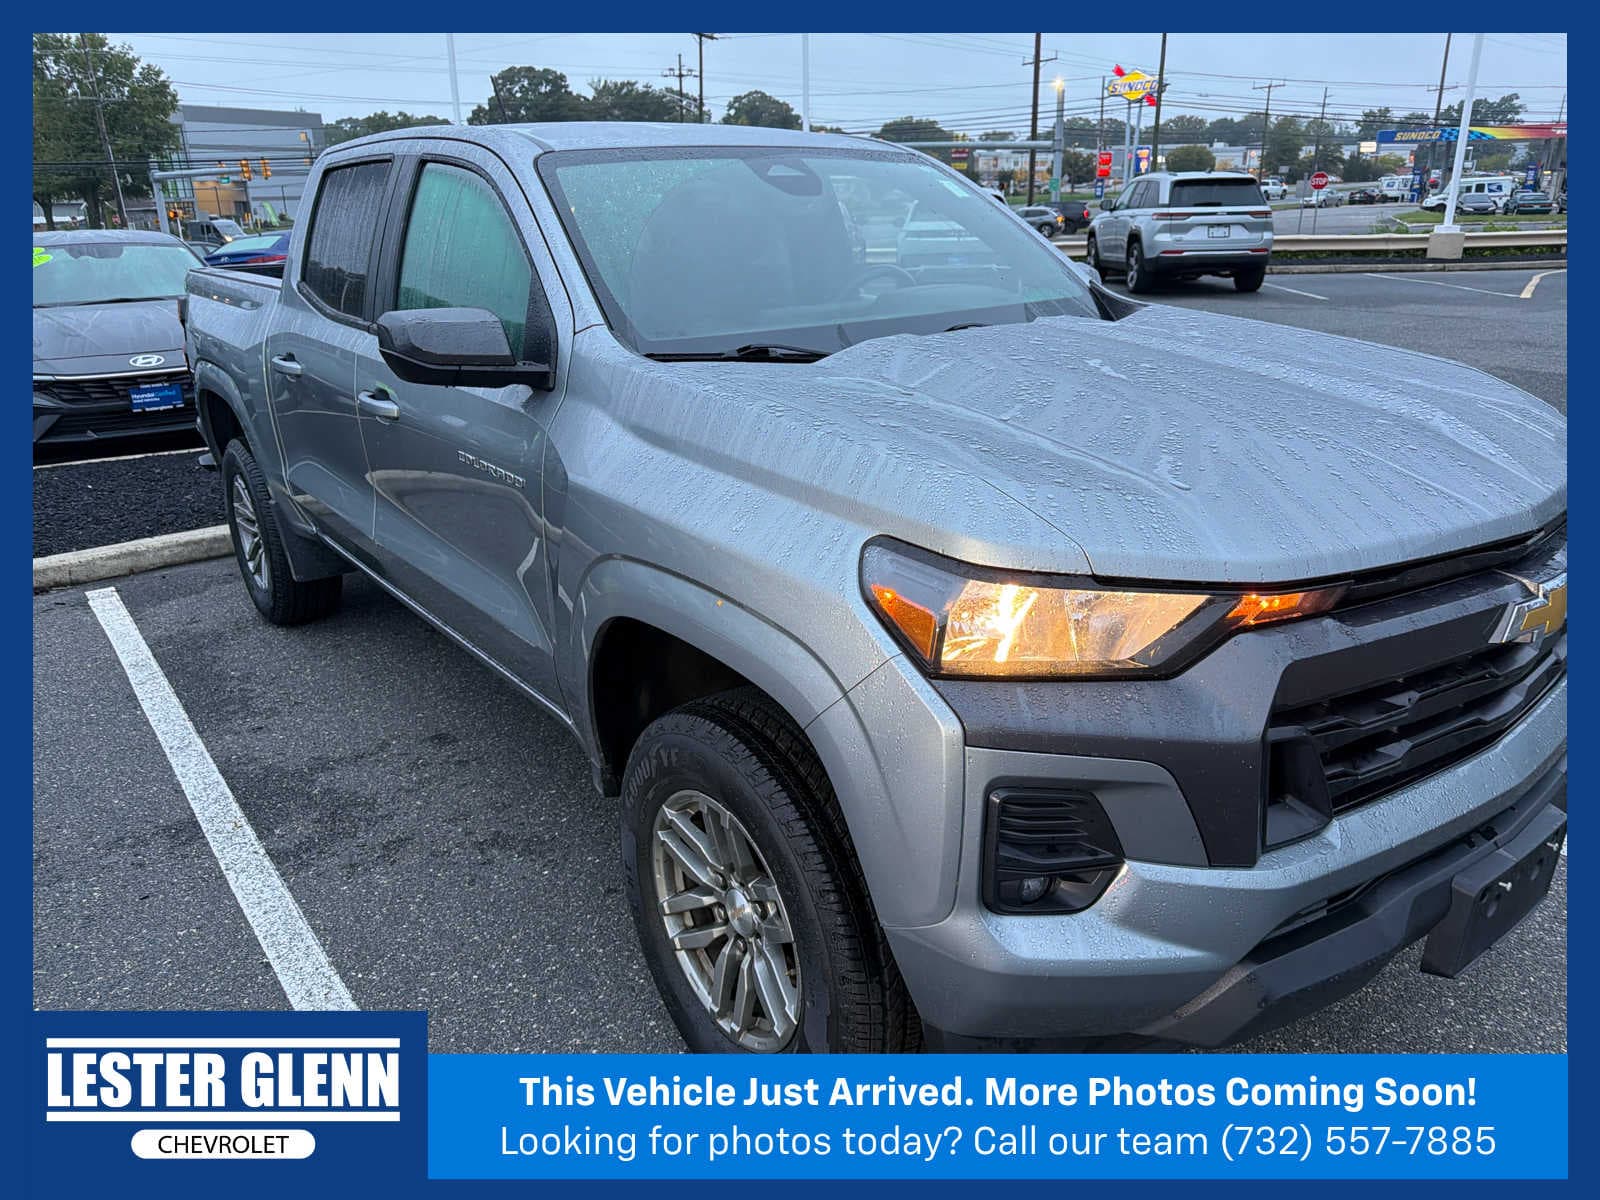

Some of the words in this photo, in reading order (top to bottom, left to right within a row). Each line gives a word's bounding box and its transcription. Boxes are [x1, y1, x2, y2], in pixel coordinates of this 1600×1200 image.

[1112, 80, 1158, 94] SUNOCO
[1394, 130, 1441, 142] SUNOCO
[1311, 177, 1328, 186] STOP
[457, 450, 526, 488] COLORADO
